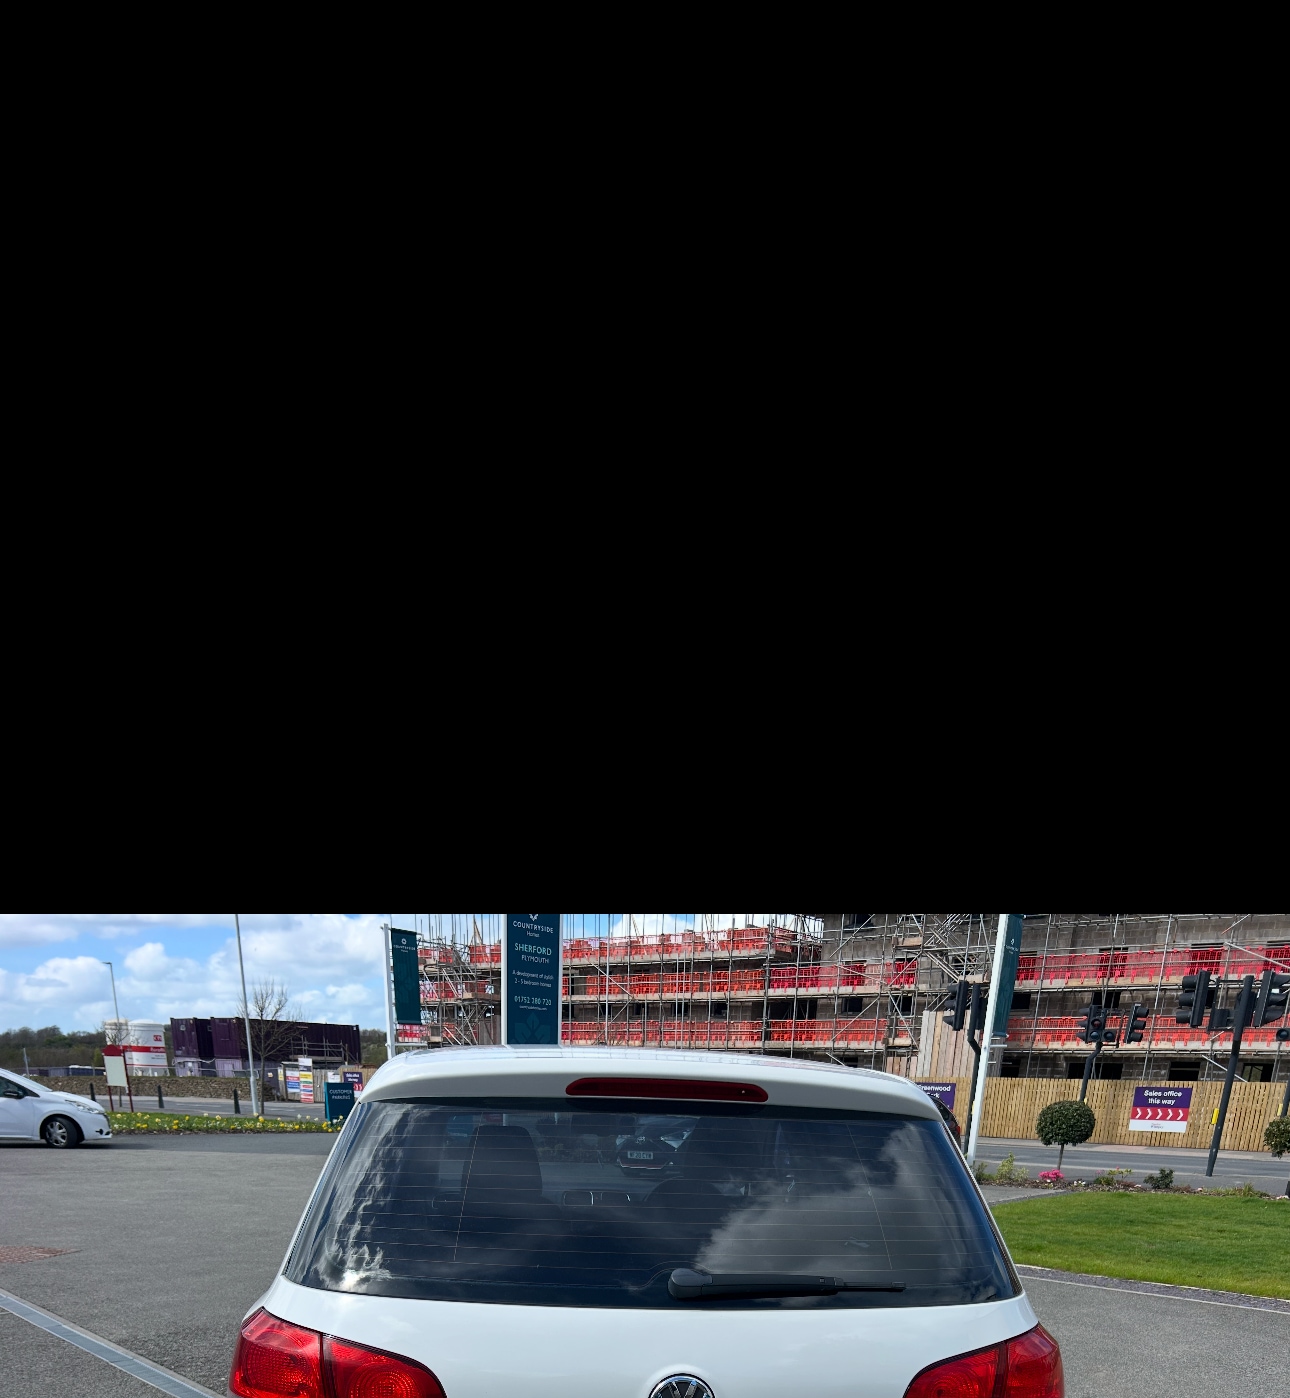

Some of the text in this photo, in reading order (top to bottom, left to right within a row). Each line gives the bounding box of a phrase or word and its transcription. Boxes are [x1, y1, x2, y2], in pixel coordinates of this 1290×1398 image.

[512, 920, 554, 934] COUNTRYSIDE
[526, 930, 540, 938] Homes
[514, 942, 552, 956] SHERFORD
[521, 954, 550, 964] PLYMOUTH
[1144, 1089, 1182, 1098] Sales office
